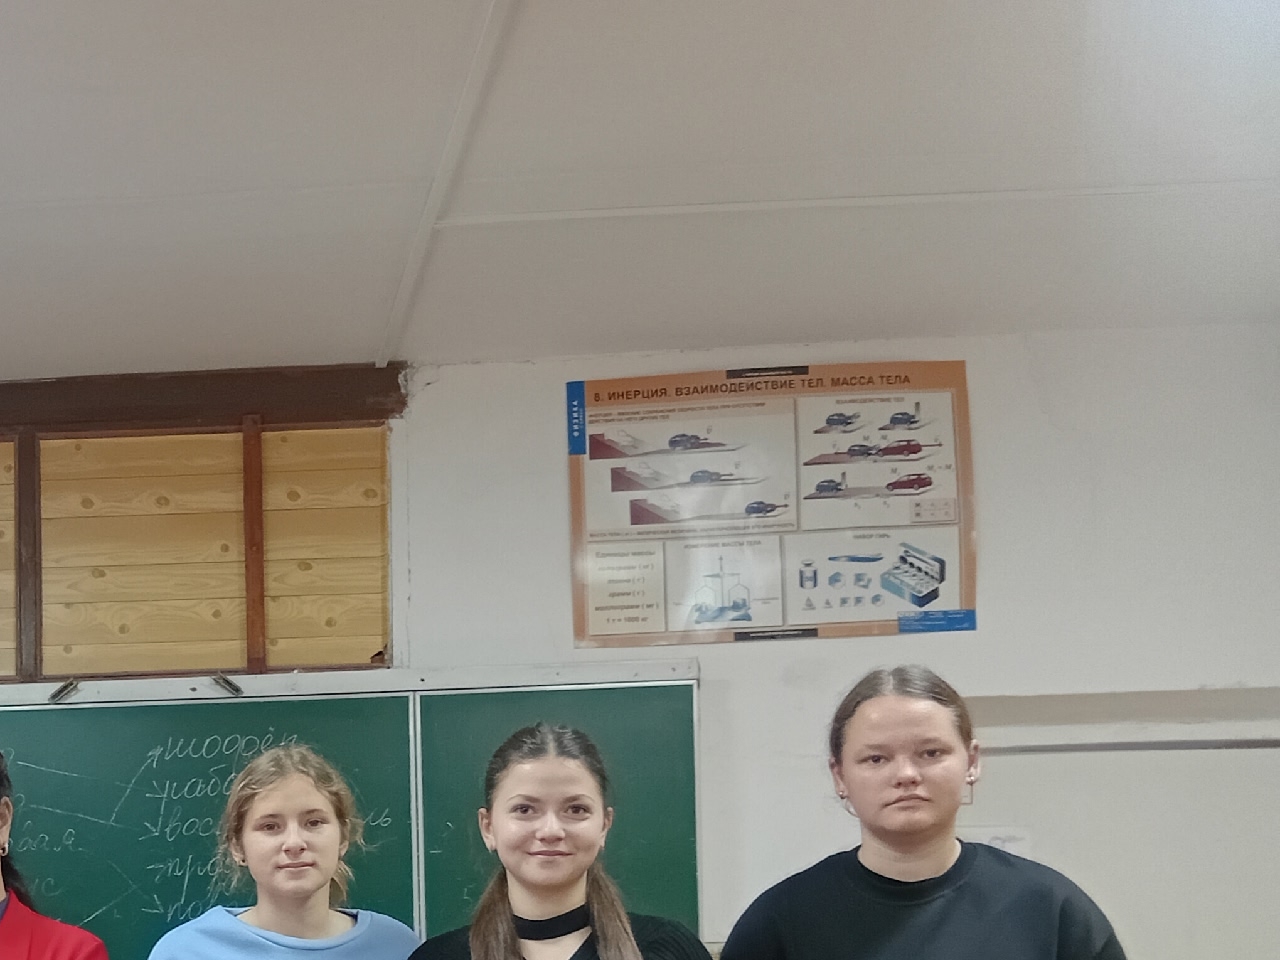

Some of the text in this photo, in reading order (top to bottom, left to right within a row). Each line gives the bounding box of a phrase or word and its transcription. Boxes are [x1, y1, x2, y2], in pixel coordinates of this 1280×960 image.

[607, 388, 671, 401] ИНЕРЦИЯ.
[675, 380, 796, 397] ВЗАИМОДЕЙСТВИЕ
[831, 376, 875, 387] МАССА
[879, 375, 911, 385] ТЕЛА
